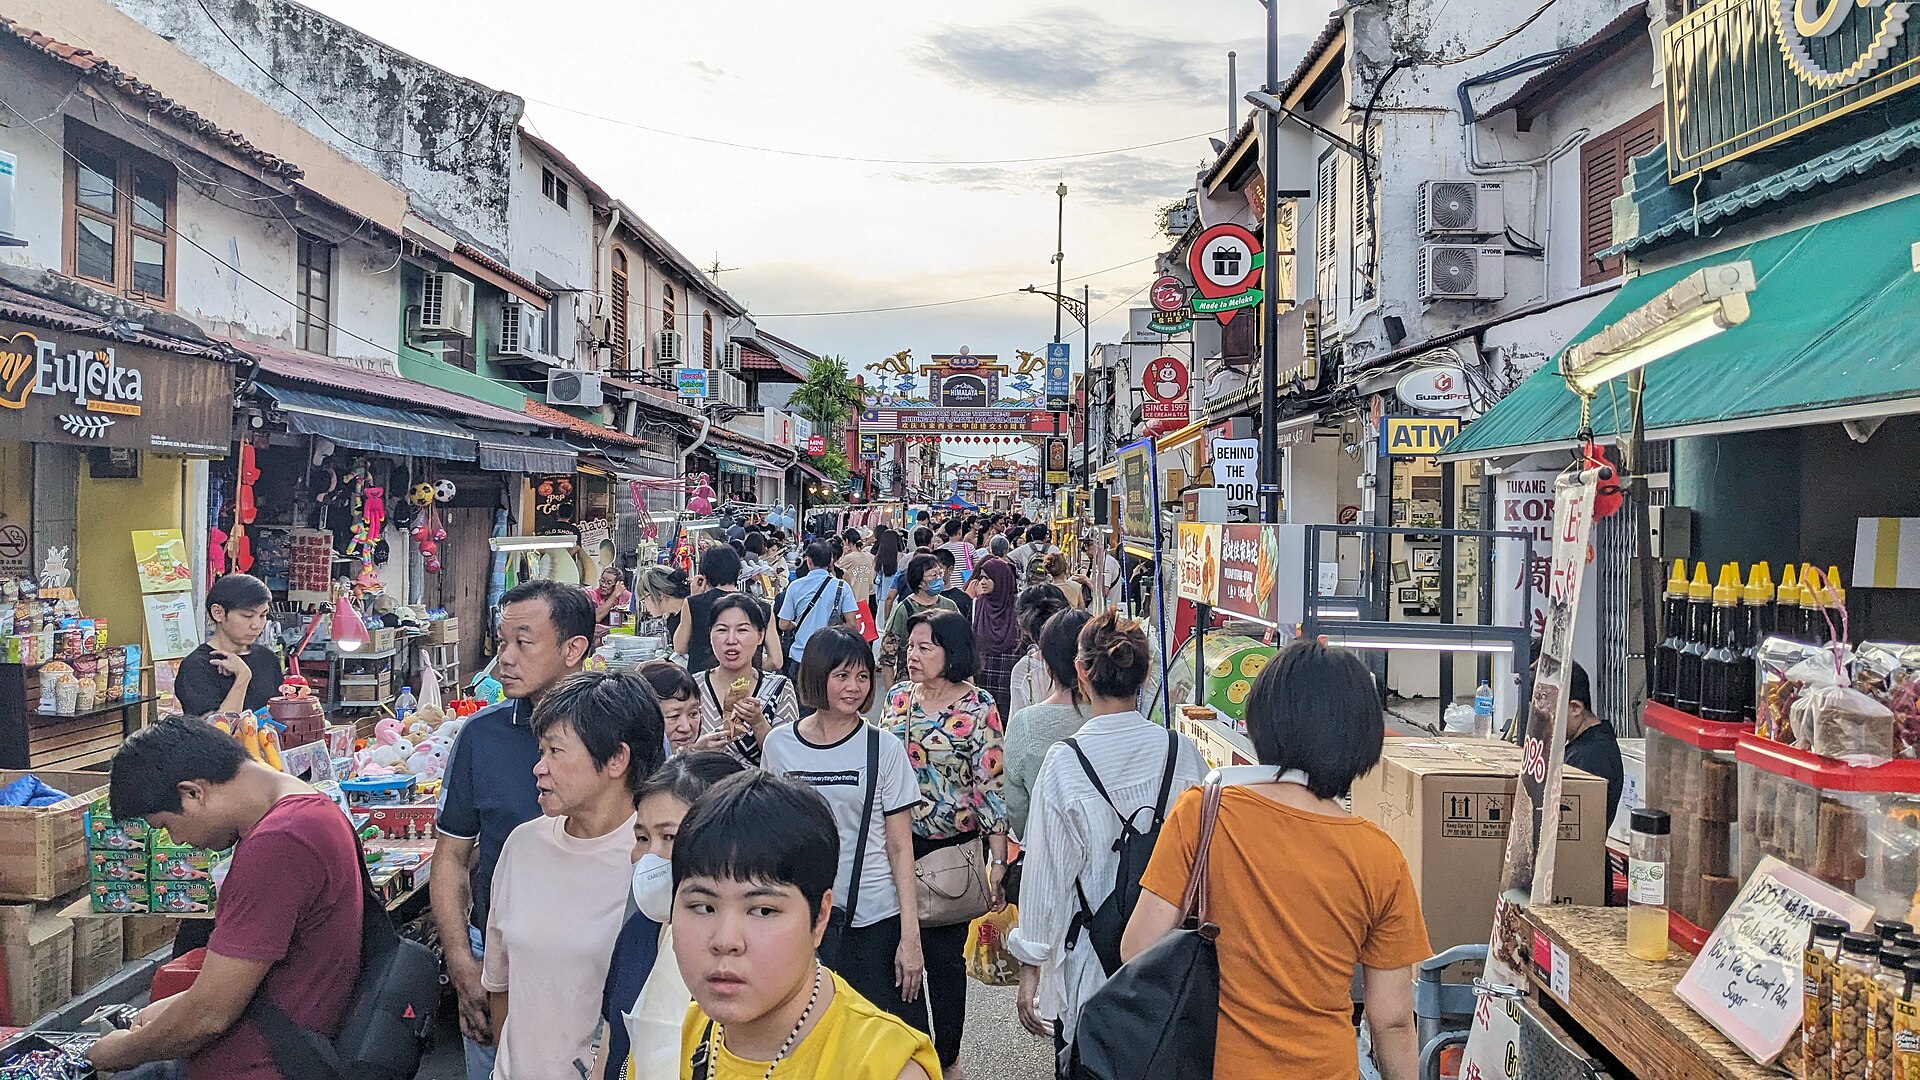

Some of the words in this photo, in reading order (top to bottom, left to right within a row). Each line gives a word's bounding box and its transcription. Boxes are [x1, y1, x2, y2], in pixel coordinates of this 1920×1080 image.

[1199, 302, 1219, 310] Made
[1229, 296, 1253, 307] Melaka
[32, 340, 143, 405] Eureka
[950, 388, 978, 396] HIMALAYA
[1416, 393, 1470, 401] GuardPro
[1145, 404, 1168, 412] SINCE
[1171, 404, 1187, 412] 1997
[1392, 425, 1455, 447] ATM
[1217, 447, 1254, 460] BEHIND
[1226, 465, 1245, 478] THE
[1217, 484, 1254, 501] OOR
[1507, 480, 1546, 494] TUKANG
[1521, 734, 1546, 783] 0%
[1728, 955, 1744, 976] Pure
[1746, 964, 1778, 999] Coconut
[1770, 983, 1791, 1010] Palm
[1722, 980, 1748, 1008] Sugar
